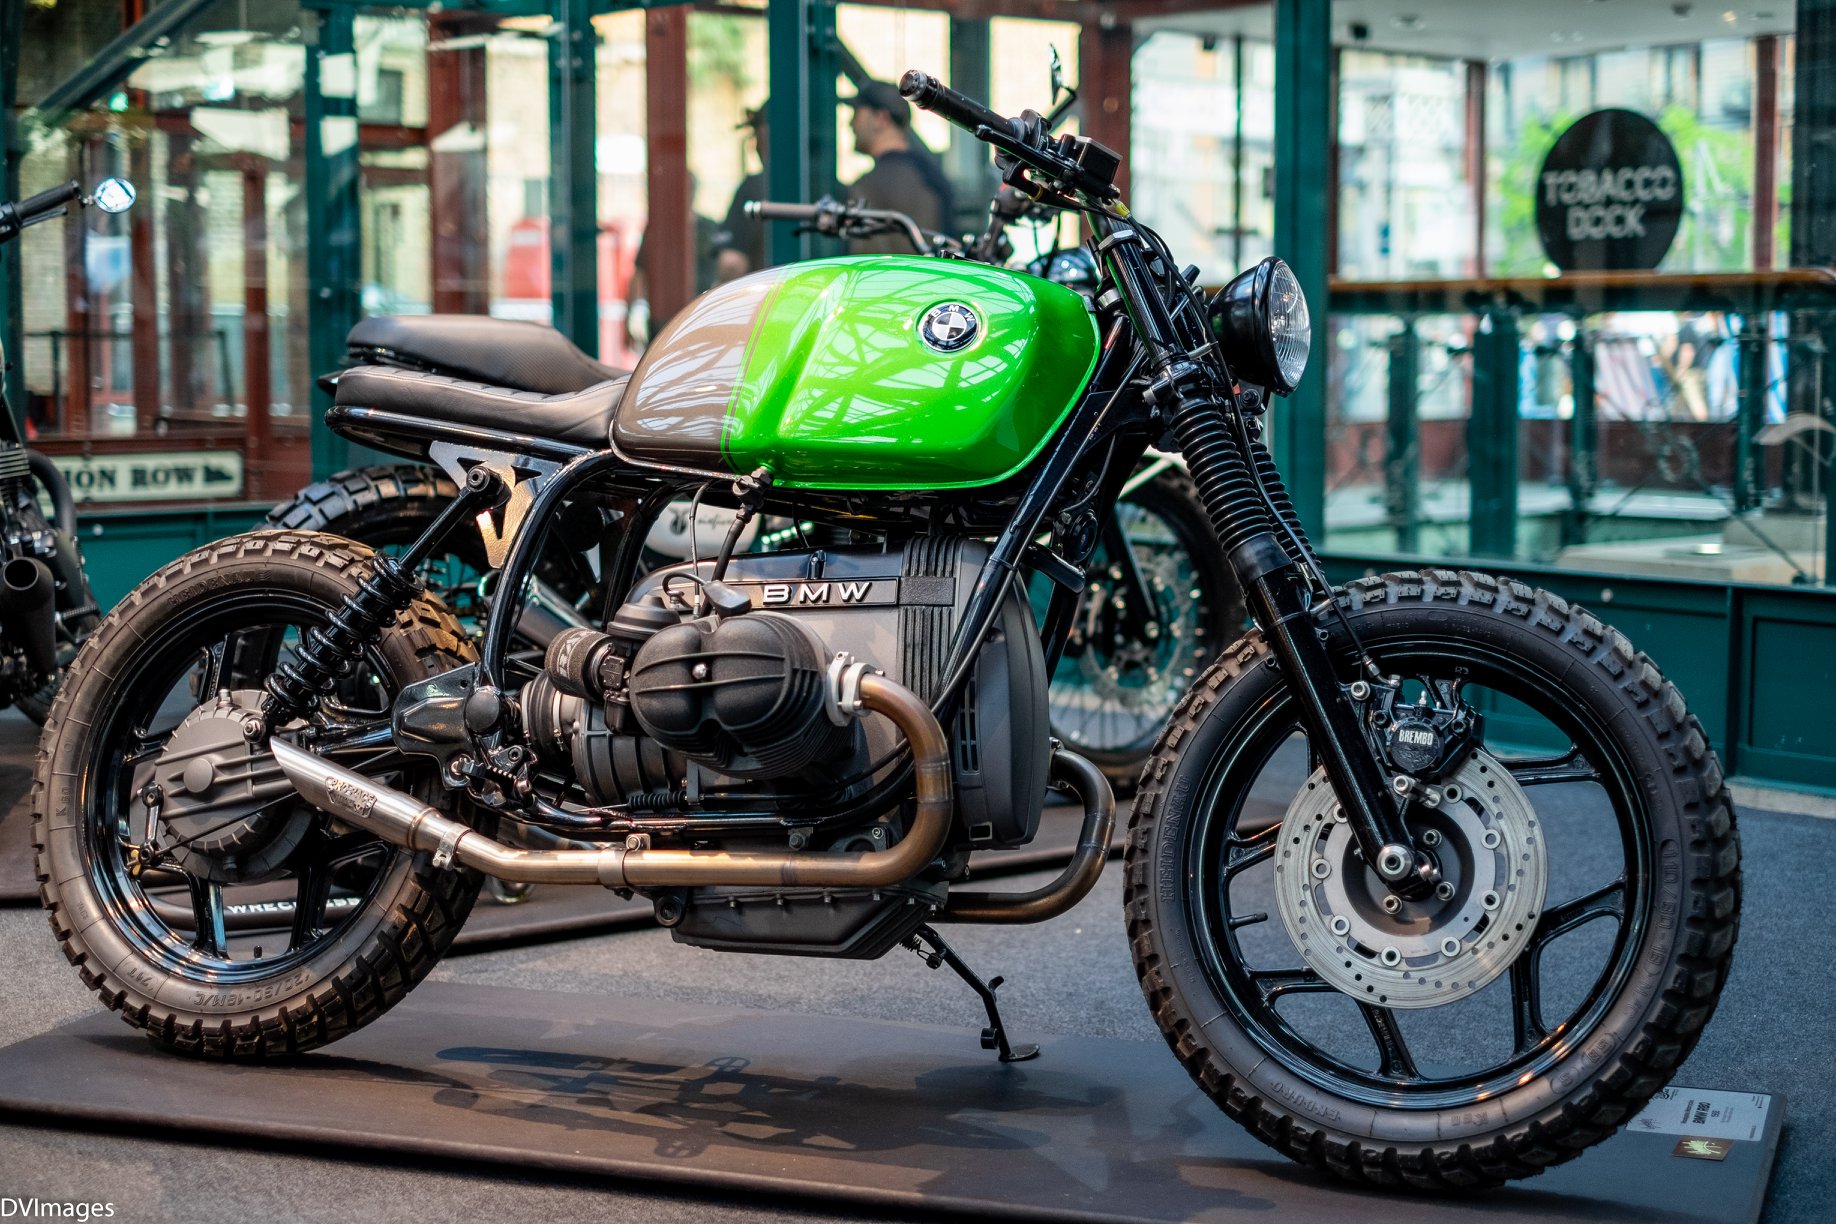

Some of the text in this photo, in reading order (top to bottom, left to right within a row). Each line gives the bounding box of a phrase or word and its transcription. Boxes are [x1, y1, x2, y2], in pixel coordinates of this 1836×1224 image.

[1543, 165, 1676, 206] TOBACCO
[1567, 203, 1646, 240] DOCK
[930, 304, 975, 321] BMW
[129, 466, 197, 487] ROW
[763, 582, 871, 605] BMW
[1399, 729, 1434, 745] BREMBO
[1160, 775, 1190, 902] HEIDENAU
[227, 897, 361, 914] WRECESS
